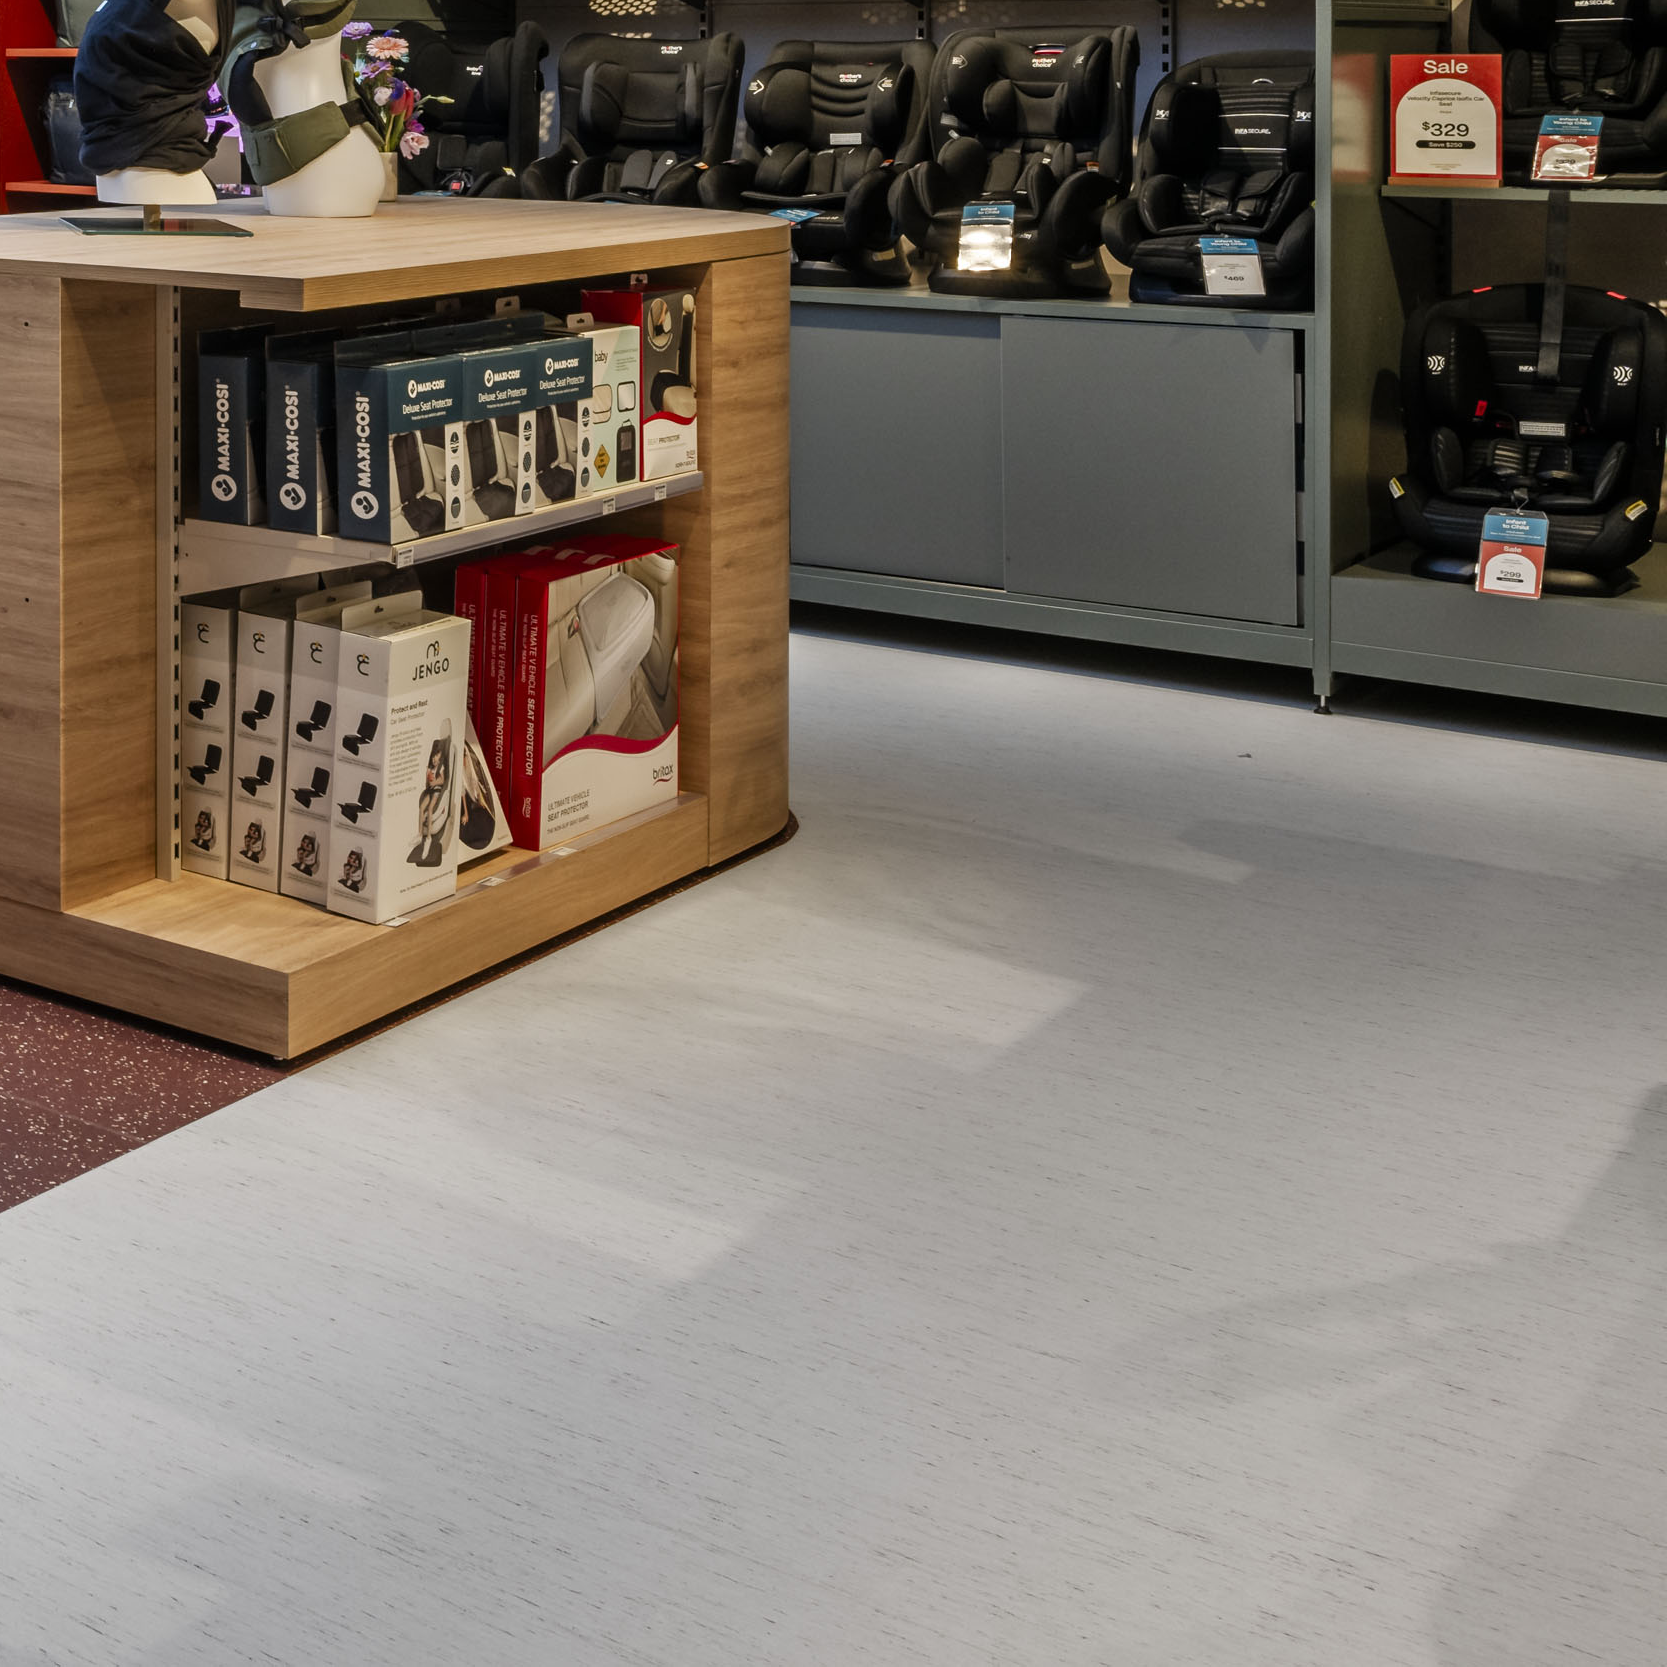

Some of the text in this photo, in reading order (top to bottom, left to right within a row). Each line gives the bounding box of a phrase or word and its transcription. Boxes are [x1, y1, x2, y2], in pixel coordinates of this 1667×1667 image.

[1423, 59, 1469, 74] Sale
[1422, 121, 1469, 137] $329
[556, 378, 566, 388] Seat
[566, 375, 586, 386] Protector
[496, 390, 507, 400] Seat
[507, 387, 528, 398] Protector
[420, 401, 432, 412] Seat
[431, 398, 453, 409] Protector
[412, 658, 450, 681] JENGO
[525, 614, 538, 776] ULTIMATE VEHICLE SEAT PROTECTOR
[390, 705, 409, 714] Protect
[409, 702, 418, 710] and
[496, 693, 505, 716] SEAT
[495, 717, 504, 770] PROTECTOR
[652, 764, 674, 780] britax
[547, 800, 589, 822] SEAT PROTECTOR
